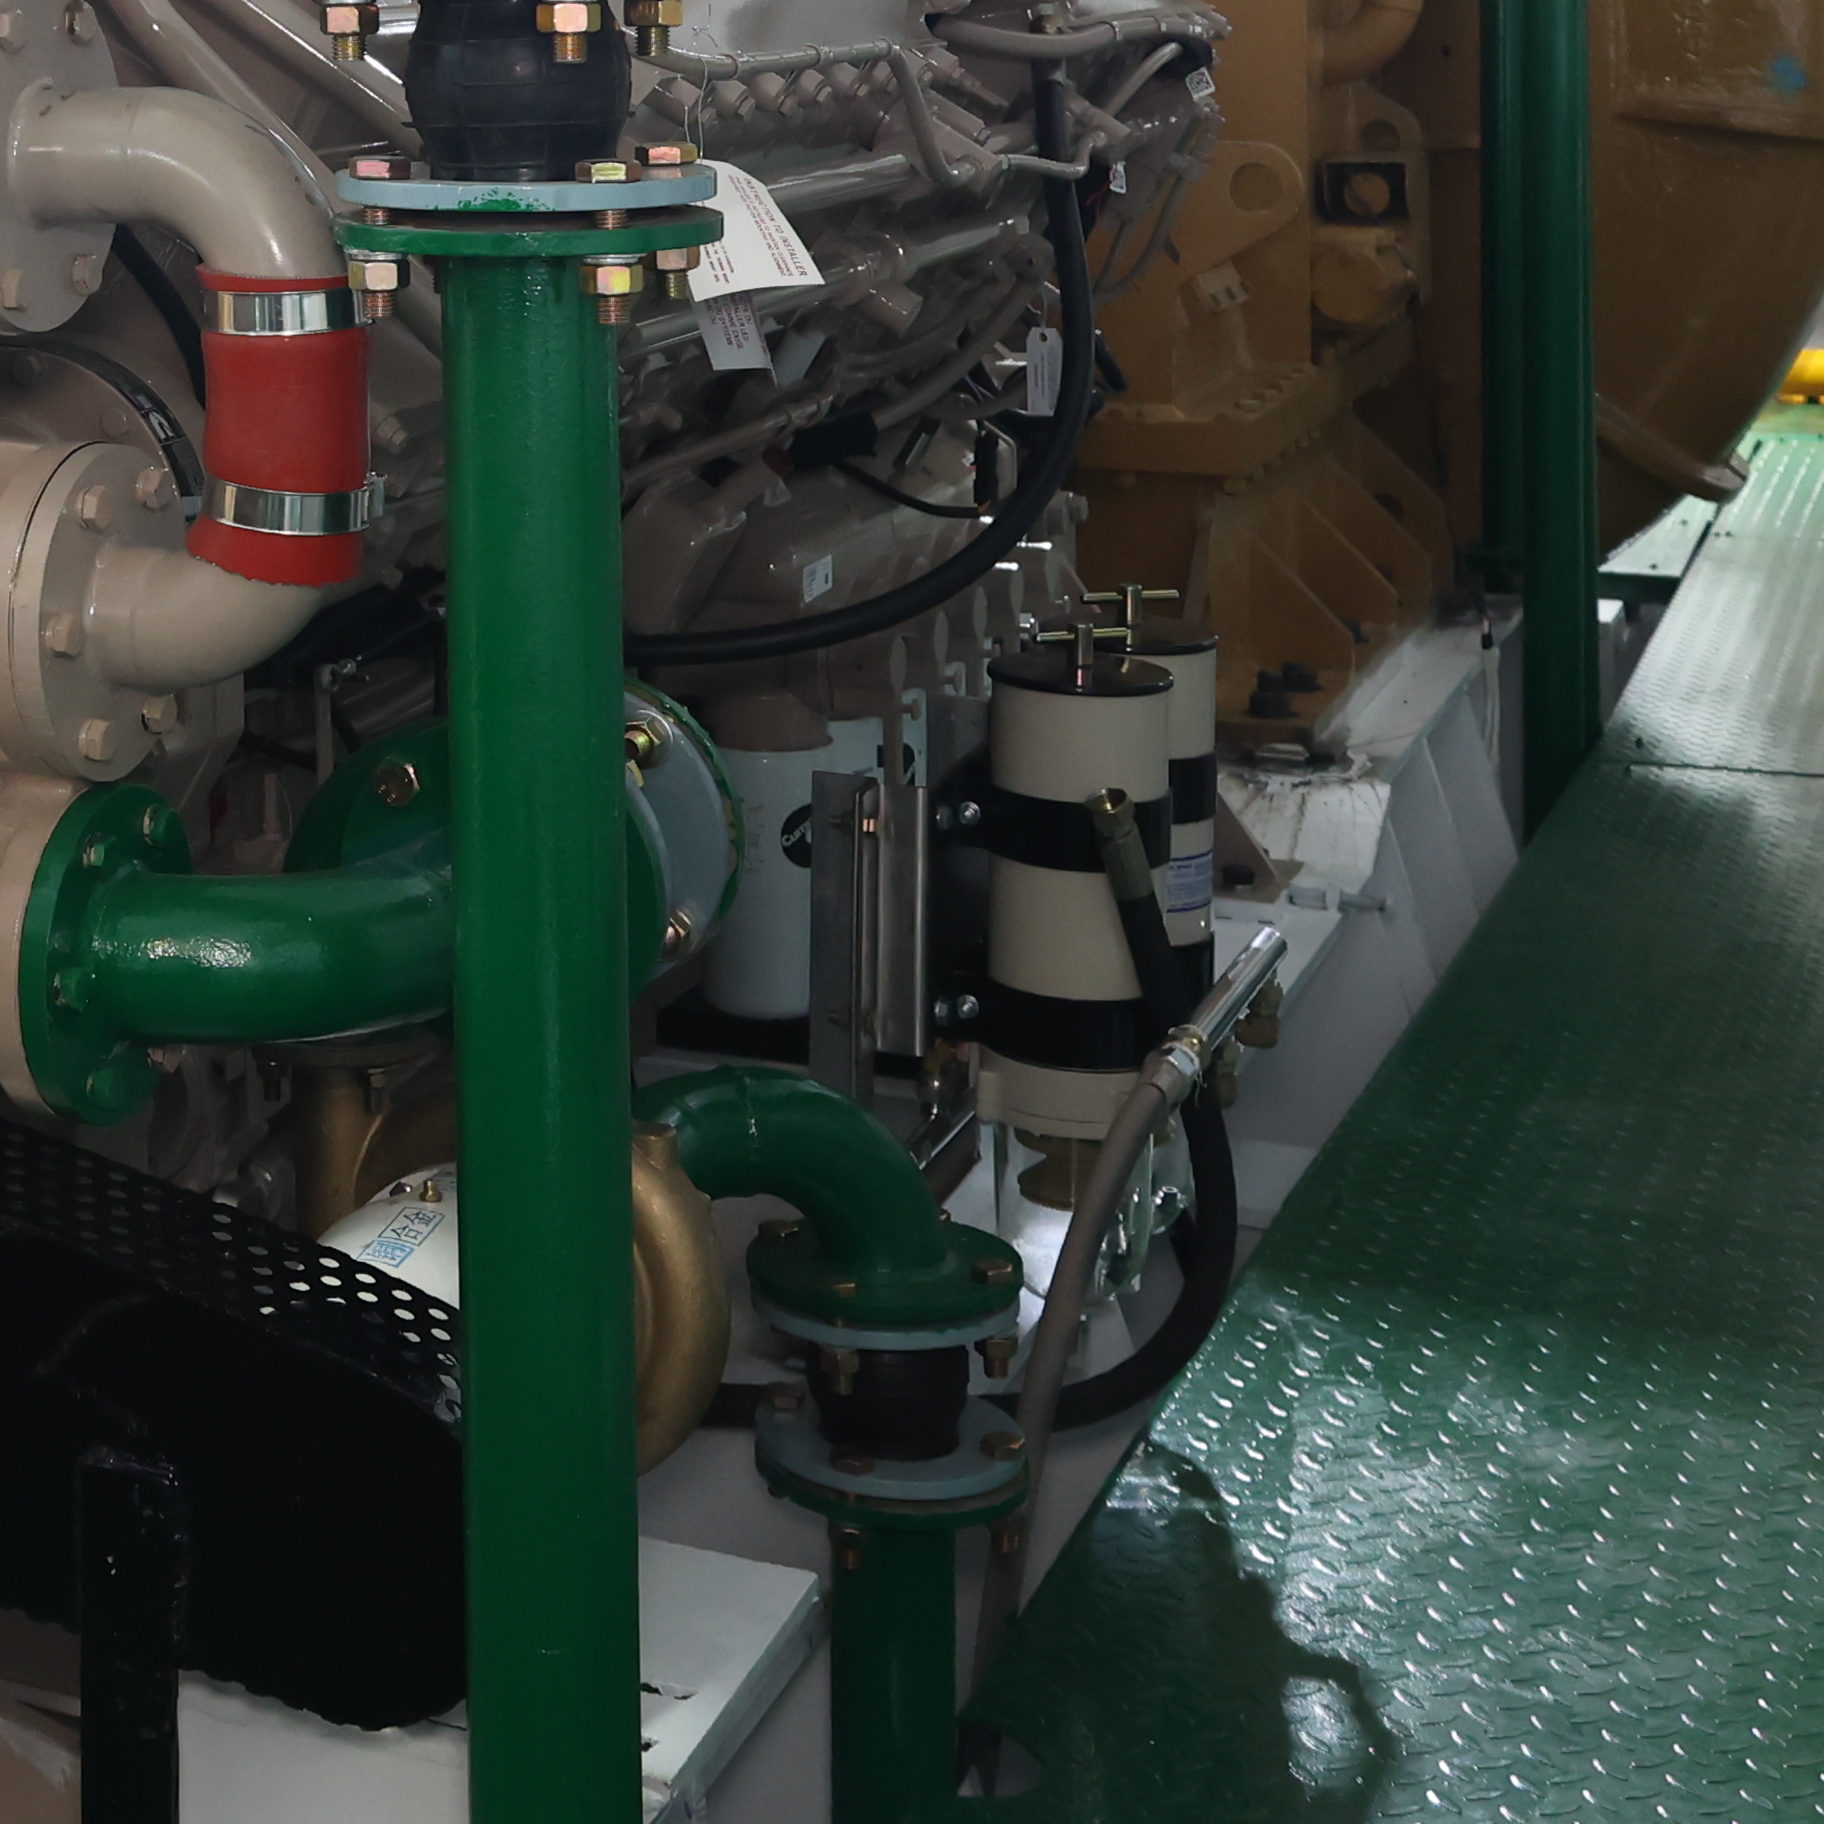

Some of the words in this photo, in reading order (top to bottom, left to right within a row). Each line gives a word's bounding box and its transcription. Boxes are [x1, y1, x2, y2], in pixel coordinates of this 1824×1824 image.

[744, 177, 777, 223] INSTRUCTION
[773, 224, 784, 234] TO
[779, 235, 808, 277] INSTALLER
